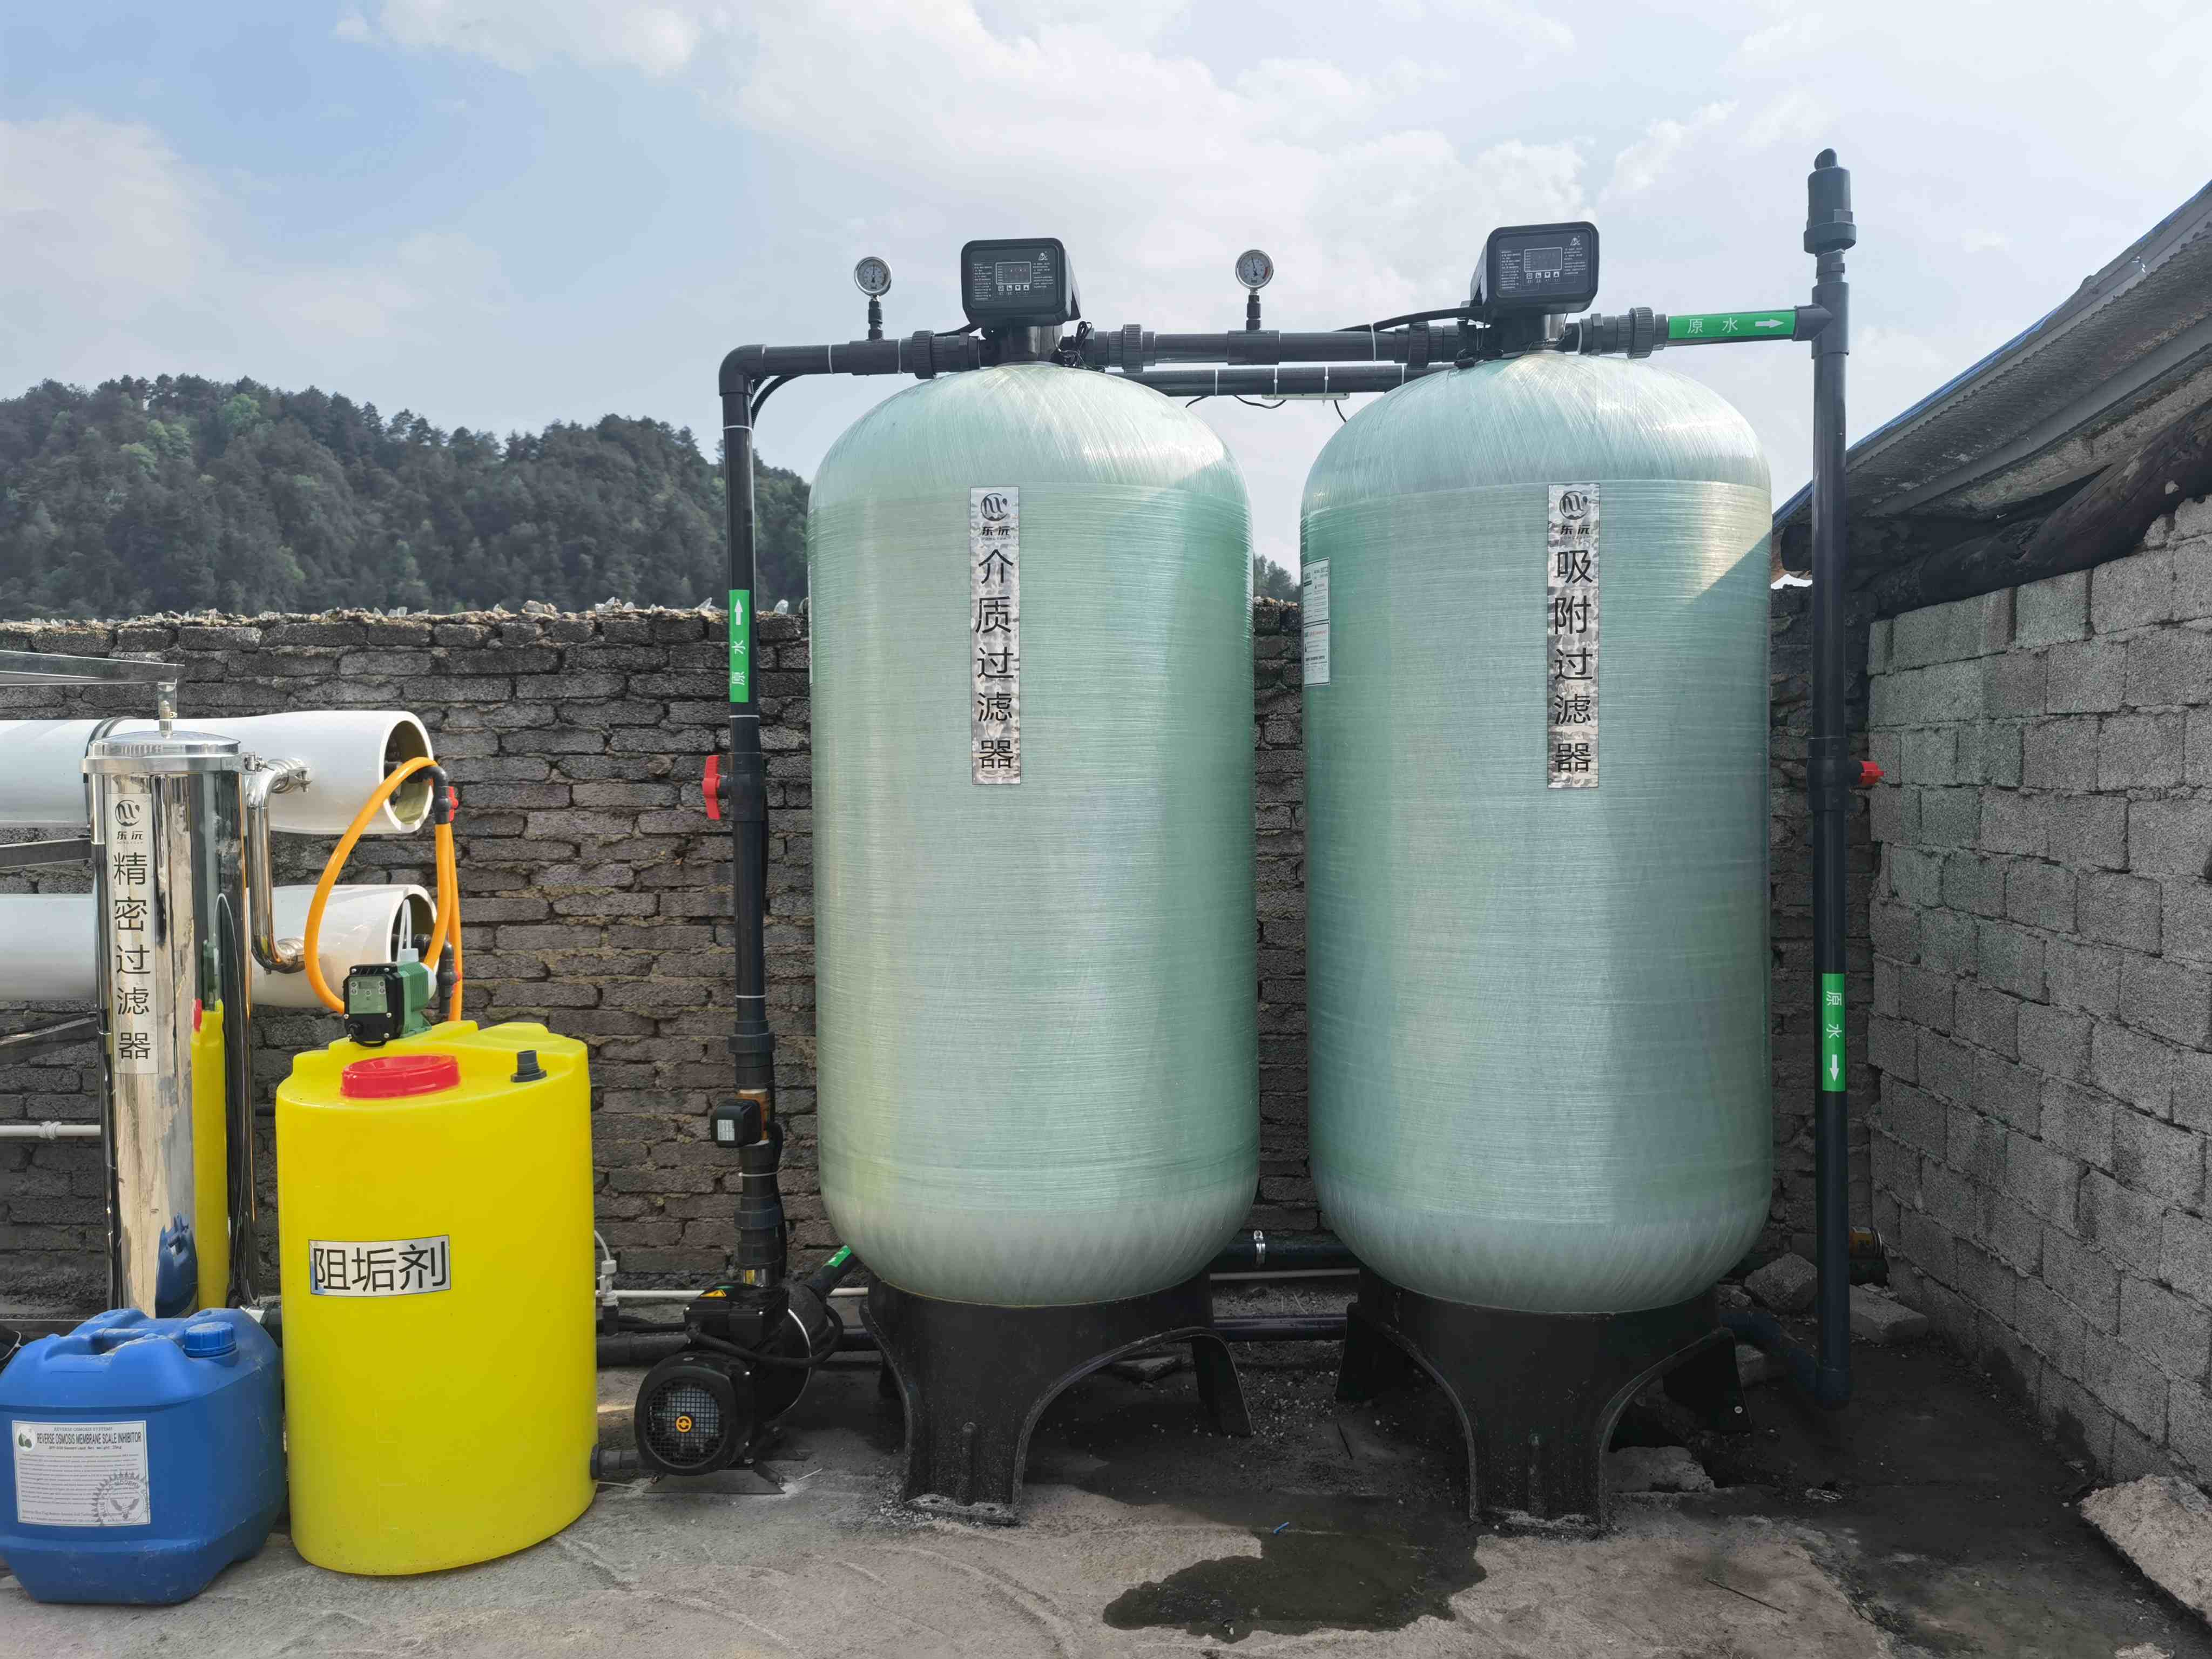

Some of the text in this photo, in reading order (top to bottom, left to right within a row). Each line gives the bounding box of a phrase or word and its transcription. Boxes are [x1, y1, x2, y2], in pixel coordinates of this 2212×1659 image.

[1687, 317, 1738, 334] 原水
[731, 640, 746, 685] 原水
[975, 549, 1014, 768] 介质过滤器
[1554, 549, 1594, 772] 吸附过滤器
[113, 852, 151, 1060] 精密过滤器
[1826, 991, 1842, 1038] 原水
[313, 1241, 447, 1292] 阻垢剂
[37, 1432, 141, 1444] REVERSE OSMOSIS MEMBRANE SCALE INHIBITOR
